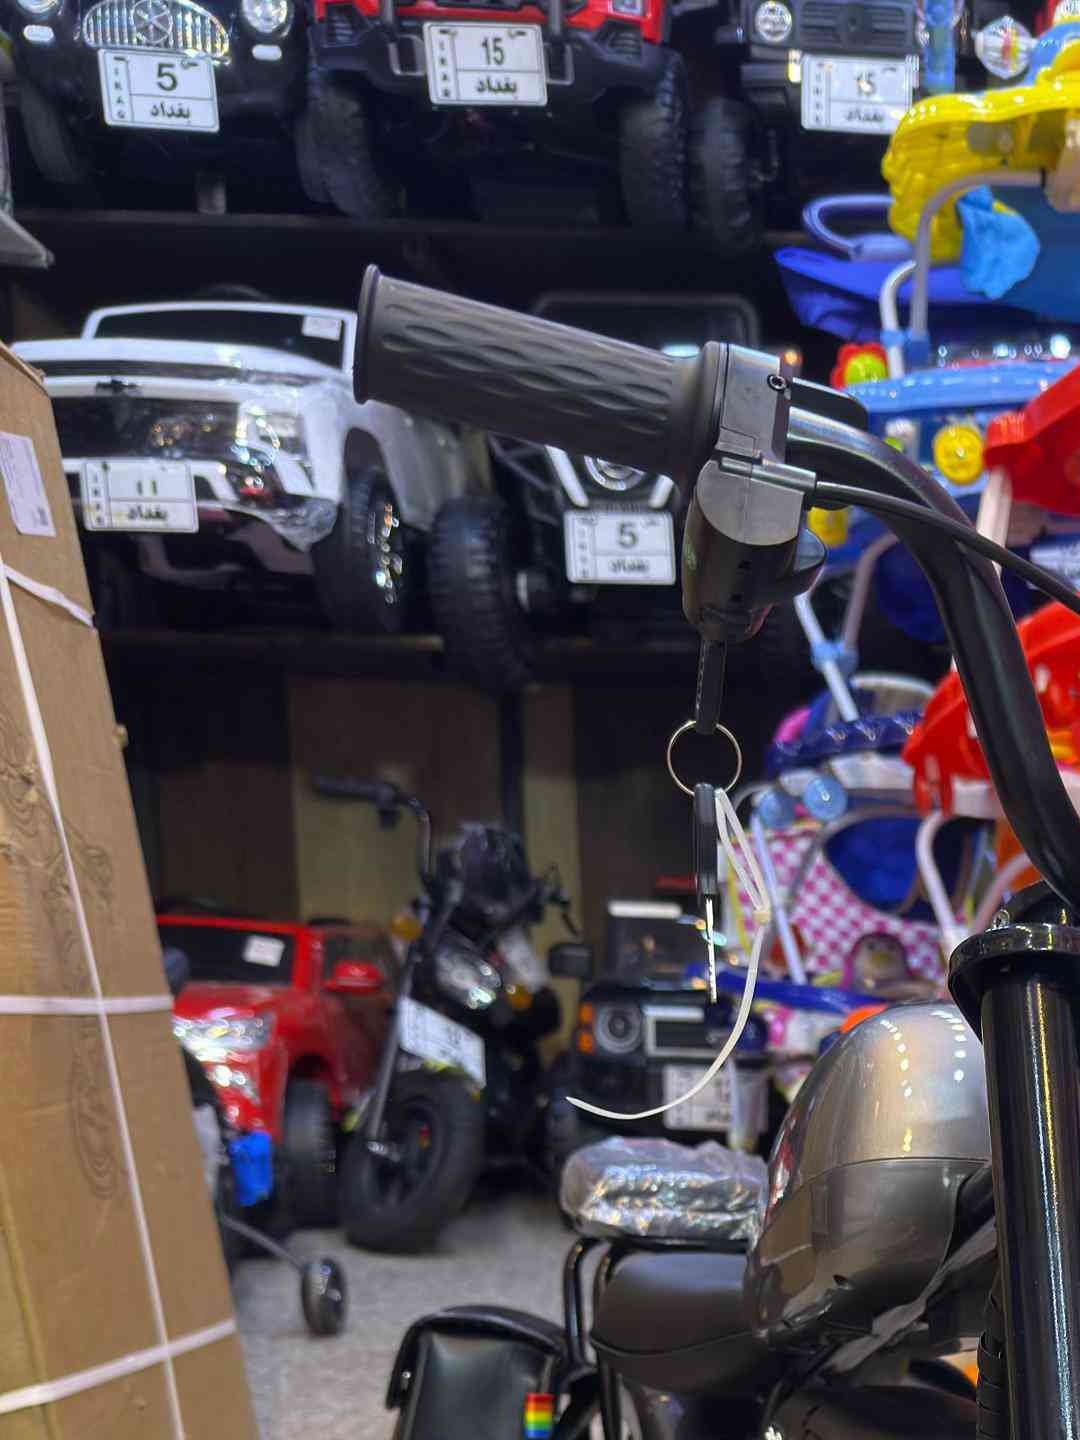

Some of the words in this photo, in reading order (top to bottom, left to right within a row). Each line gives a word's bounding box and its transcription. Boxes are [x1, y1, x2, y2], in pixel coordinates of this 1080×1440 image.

[482, 35, 505, 66] 15
[157, 62, 178, 92] 5
[150, 101, 191, 126] بغداد
[617, 521, 638, 549] 5
